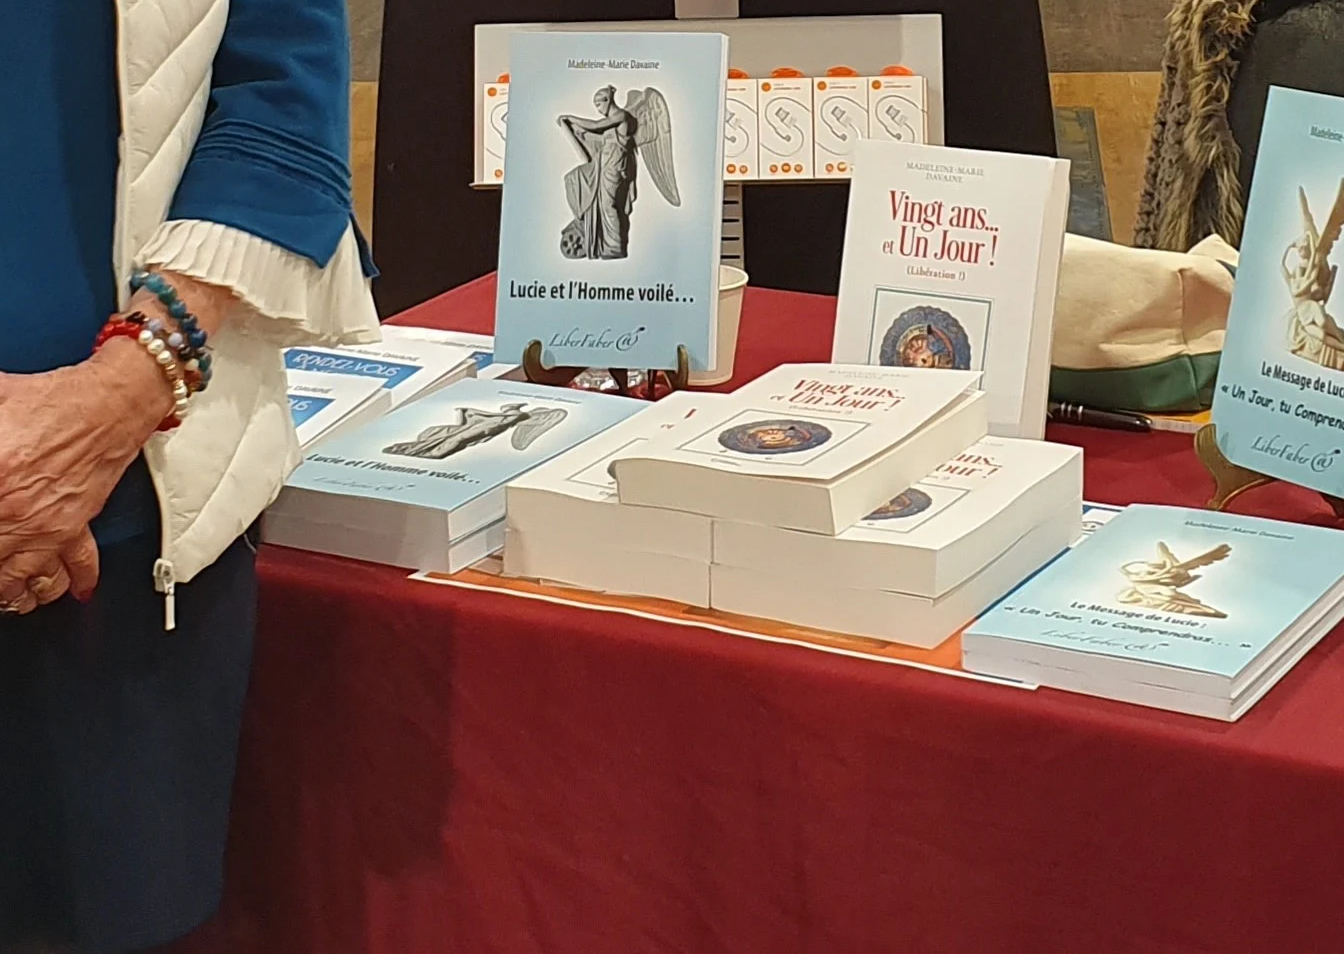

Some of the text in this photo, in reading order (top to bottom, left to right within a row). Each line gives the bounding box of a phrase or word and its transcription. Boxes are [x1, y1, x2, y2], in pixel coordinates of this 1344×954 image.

[889, 190, 999, 232] Vingt ans...
[882, 238, 895, 256] et
[898, 225, 930, 259] Un
[932, 230, 985, 265] Jour
[907, 265, 954, 281] (Libération
[510, 280, 548, 301] Lucie
[550, 284, 565, 301] et
[568, 280, 635, 303] l'Homme
[292, 353, 401, 377] RENDEZ-VOUS
[1261, 360, 1273, 378] Le
[1274, 364, 1312, 393] Message
[1313, 376, 1325, 392] de
[793, 377, 850, 400] Vingt
[1232, 384, 1247, 401] Un
[1249, 388, 1277, 412] Jour,
[1280, 399, 1293, 415] tu
[788, 391, 826, 408] Un
[829, 394, 888, 413] Jour
[305, 453, 344, 466] Lucie
[345, 458, 359, 468] et
[360, 460, 426, 477] l'Homme
[1070, 600, 1198, 629] Le Message de Lucie
[1089, 617, 1109, 628] tu
